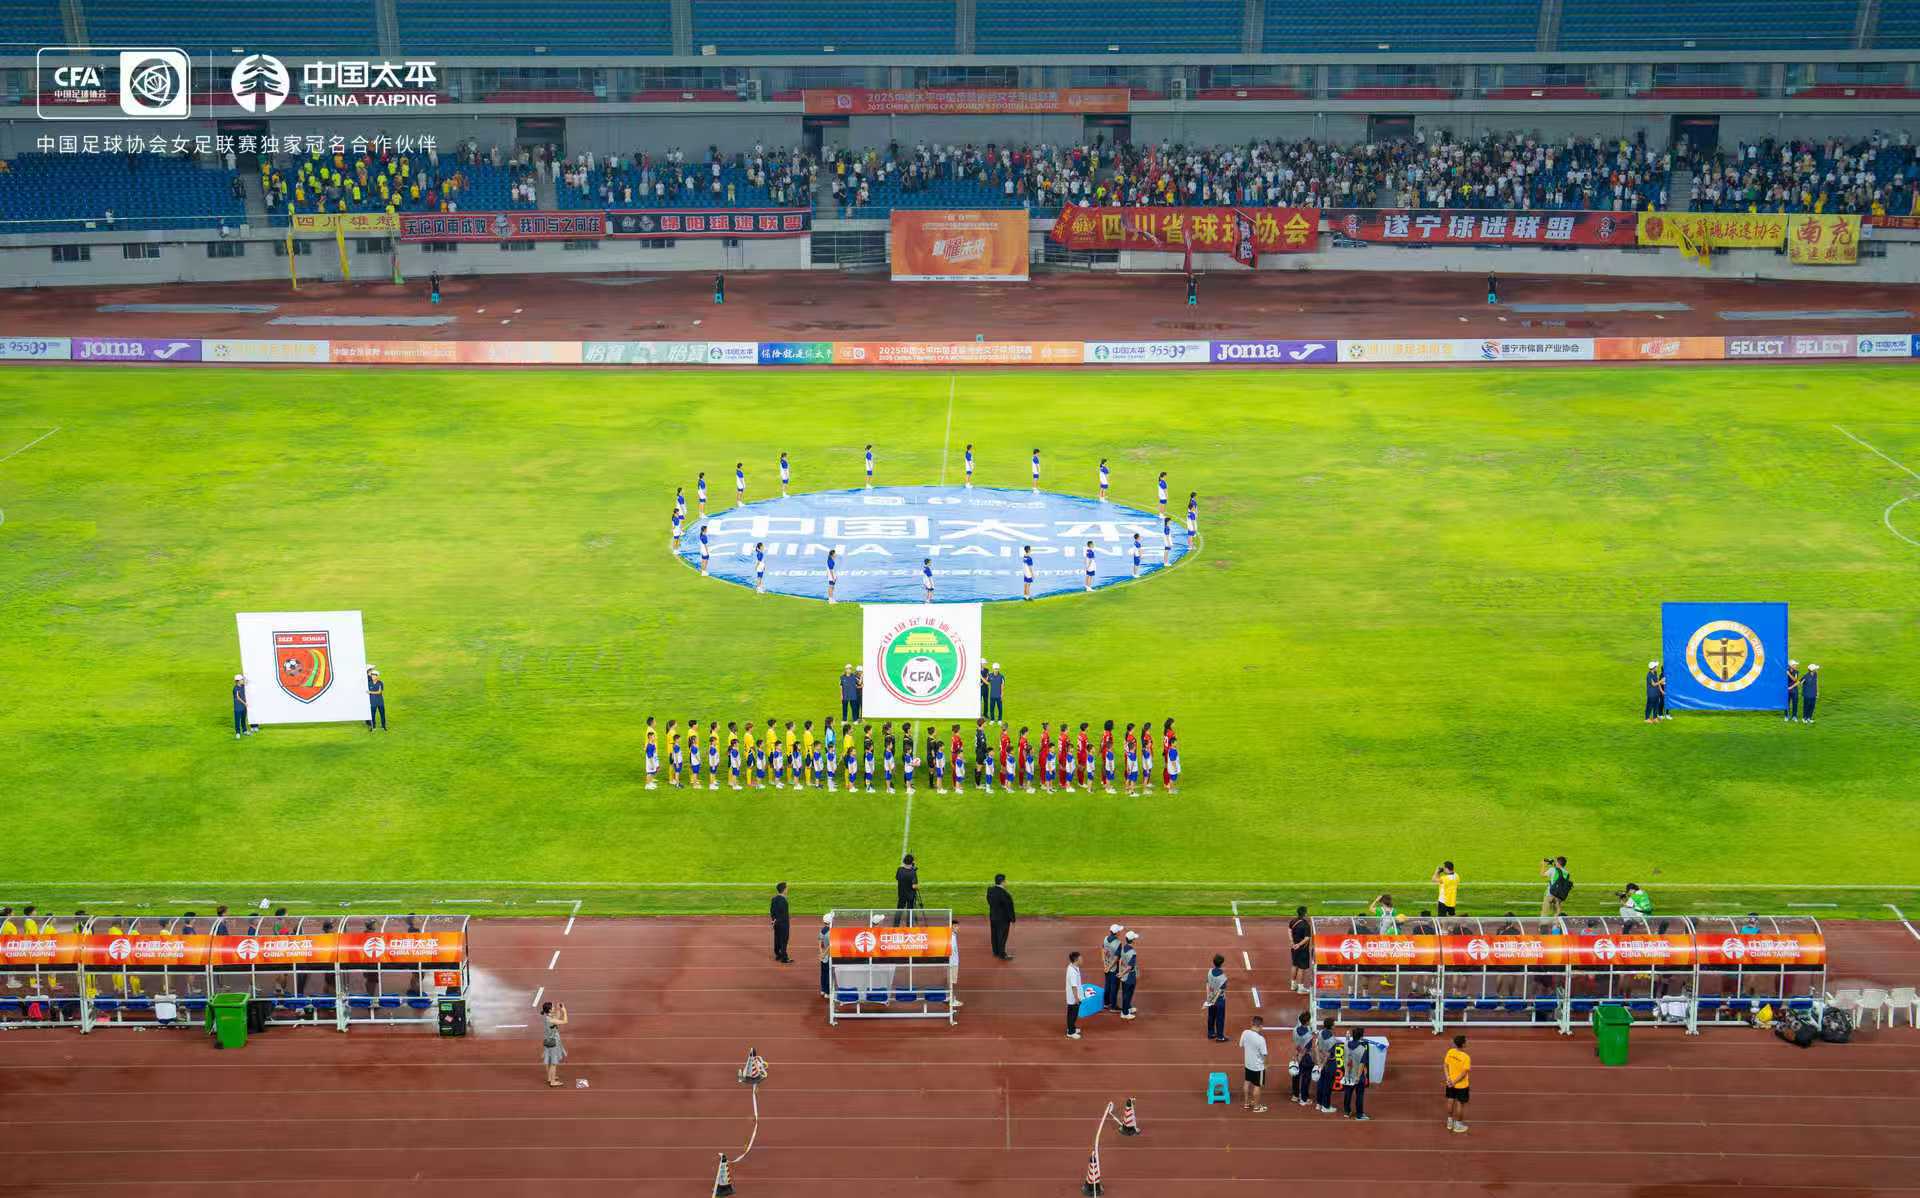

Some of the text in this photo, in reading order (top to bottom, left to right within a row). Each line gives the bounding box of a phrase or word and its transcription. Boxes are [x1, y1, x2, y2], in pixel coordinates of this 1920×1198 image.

[520, 217, 600, 233] 我们与之同在
[1384, 215, 1574, 240] 遂宁球迷联盟
[1797, 217, 1854, 244] 南充
[1112, 346, 1145, 354] 中国太平
[1502, 343, 1580, 353] 遂宁市体育产业协会
[1730, 341, 1784, 355] SELECT
[1795, 340, 1848, 354] SELECT
[707, 515, 1166, 541] 中国太平
[909, 671, 934, 682] CFA
[390, 938, 438, 948] 中国太平
[880, 933, 928, 943] 中国太平
[7, 940, 57, 950] 中国太平
[135, 940, 184, 950] 中国太平
[263, 939, 312, 949] 中国太平
[1367, 940, 1416, 950] 中国太平
[1494, 940, 1543, 950] 中国太平
[1620, 941, 1670, 950] 中国太平
[1748, 940, 1800, 950] 中国太平
